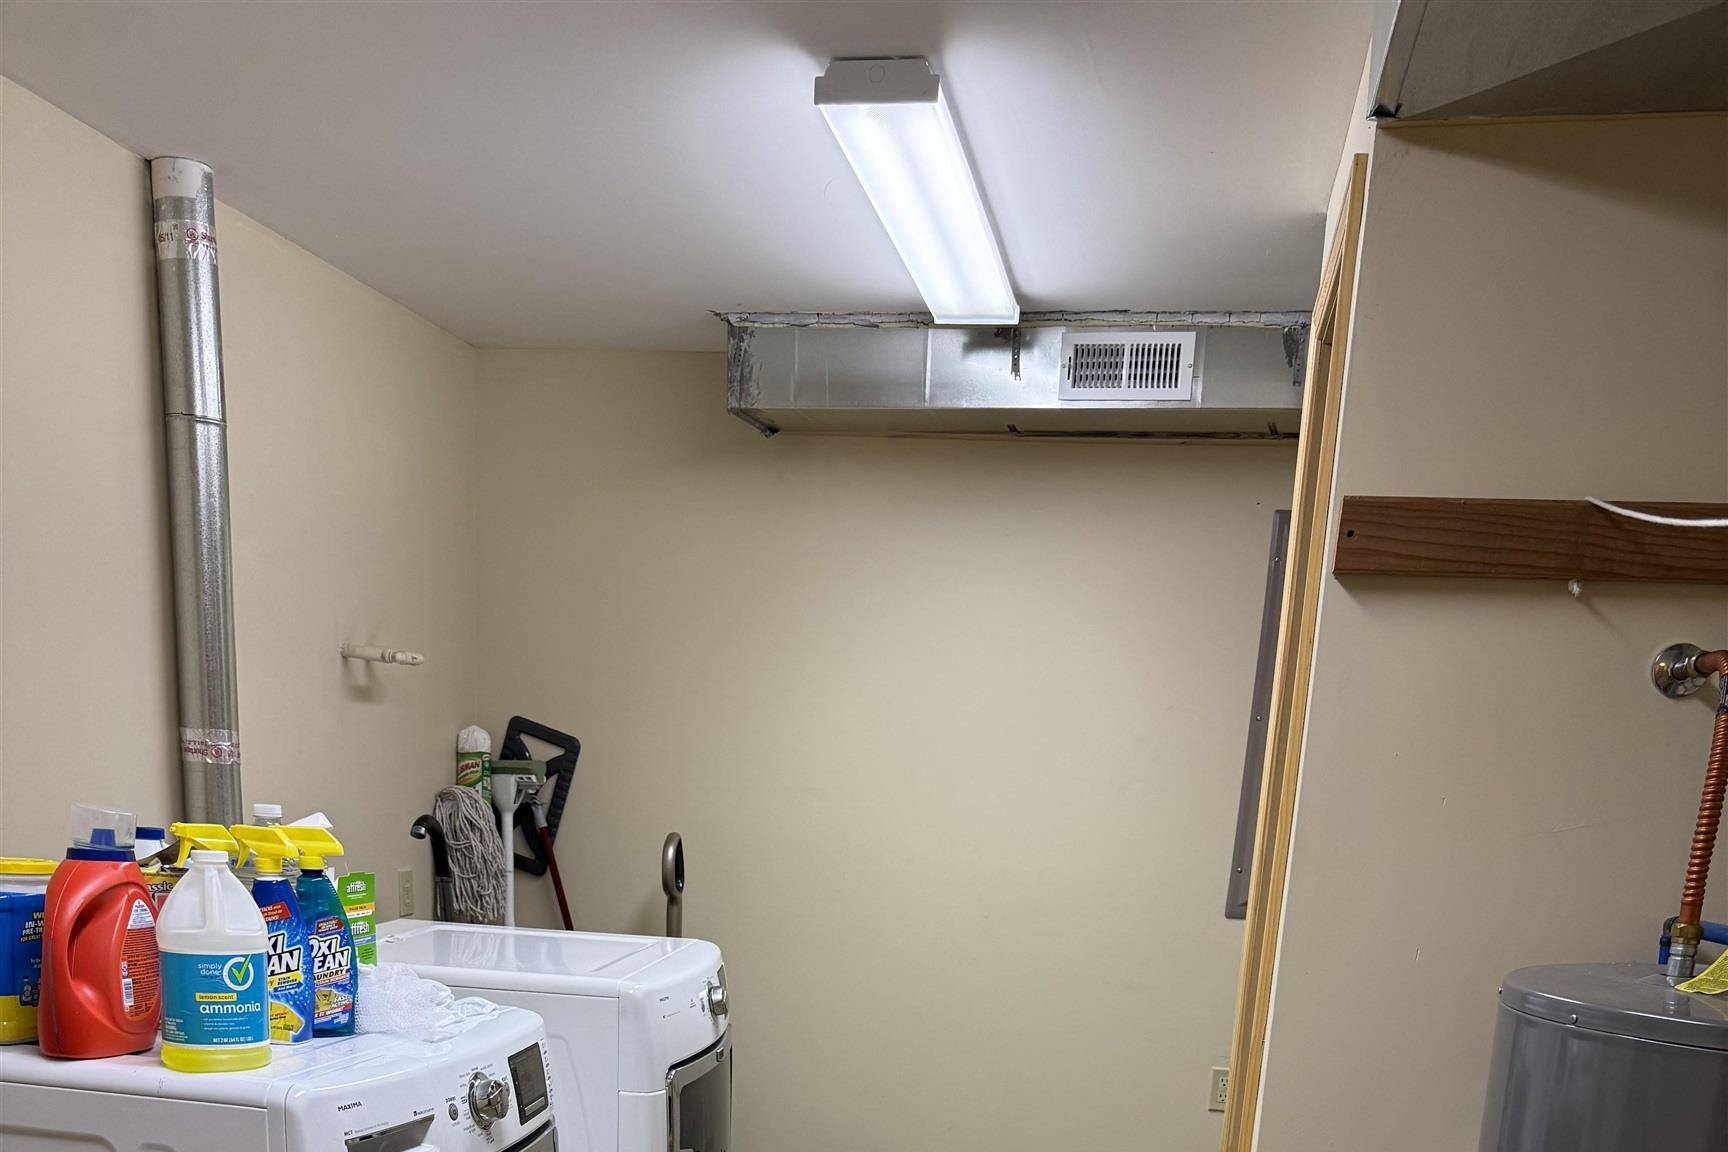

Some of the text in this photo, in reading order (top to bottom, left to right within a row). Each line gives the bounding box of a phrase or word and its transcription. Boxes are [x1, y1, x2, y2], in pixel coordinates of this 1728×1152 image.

[351, 921, 370, 936] ffresh
[268, 934, 284, 956] XI
[197, 962, 222, 970] simply
[268, 948, 300, 976] AN
[314, 950, 349, 973] EAN
[200, 1001, 261, 1014] ammonia
[337, 1101, 363, 1112] MAXIMA
